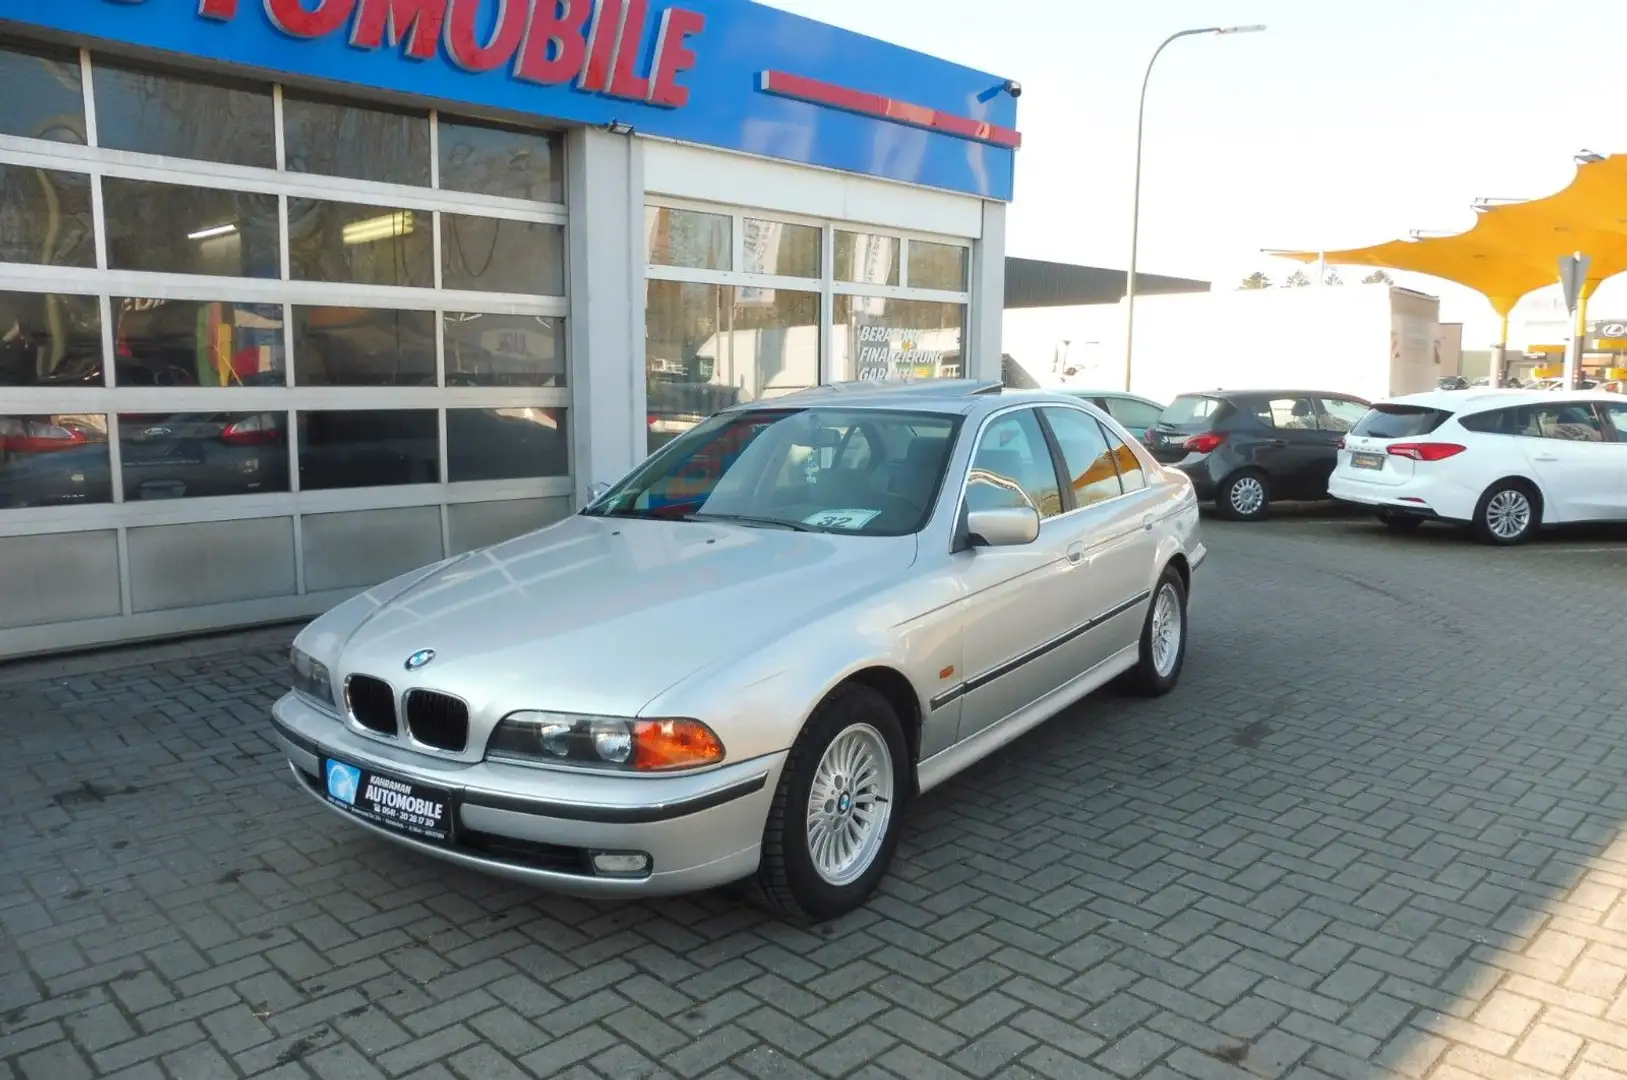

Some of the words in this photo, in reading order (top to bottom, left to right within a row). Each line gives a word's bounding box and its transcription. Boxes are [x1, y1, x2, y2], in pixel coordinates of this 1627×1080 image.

[369, 775, 412, 795] KAHRAMAN
[365, 785, 443, 819] AUTOMOBILE
[382, 806, 396, 818] 0541
[400, 812, 408, 821] 20
